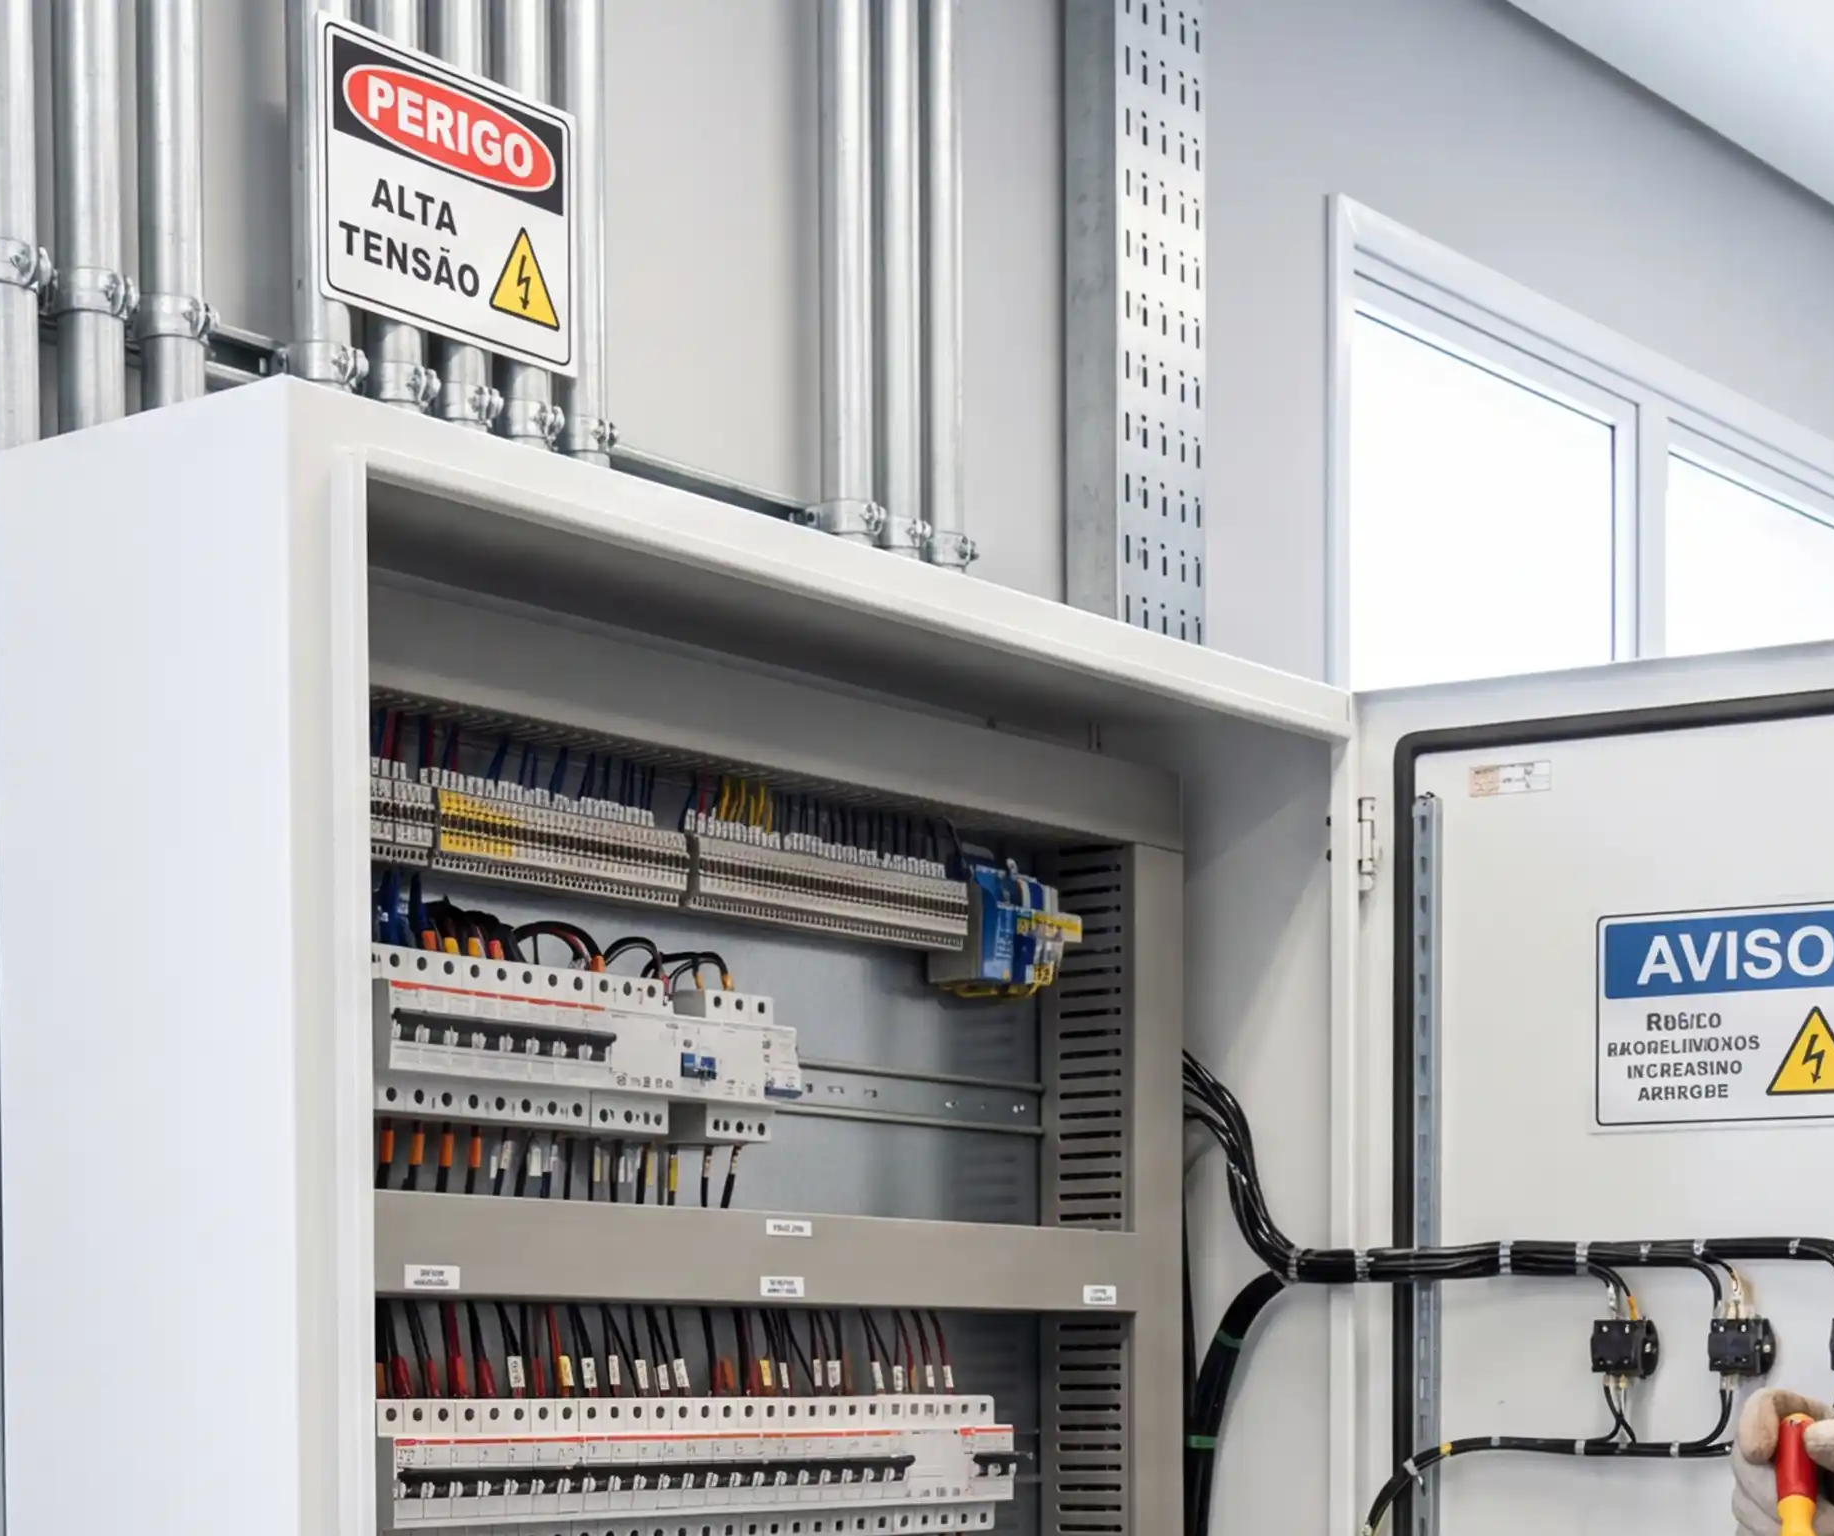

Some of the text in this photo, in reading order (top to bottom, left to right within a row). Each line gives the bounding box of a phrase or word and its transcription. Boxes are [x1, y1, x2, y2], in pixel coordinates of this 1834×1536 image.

[367, 74, 534, 179] PERIGO
[371, 178, 458, 236] ALTA
[338, 220, 481, 298] TENSÃO
